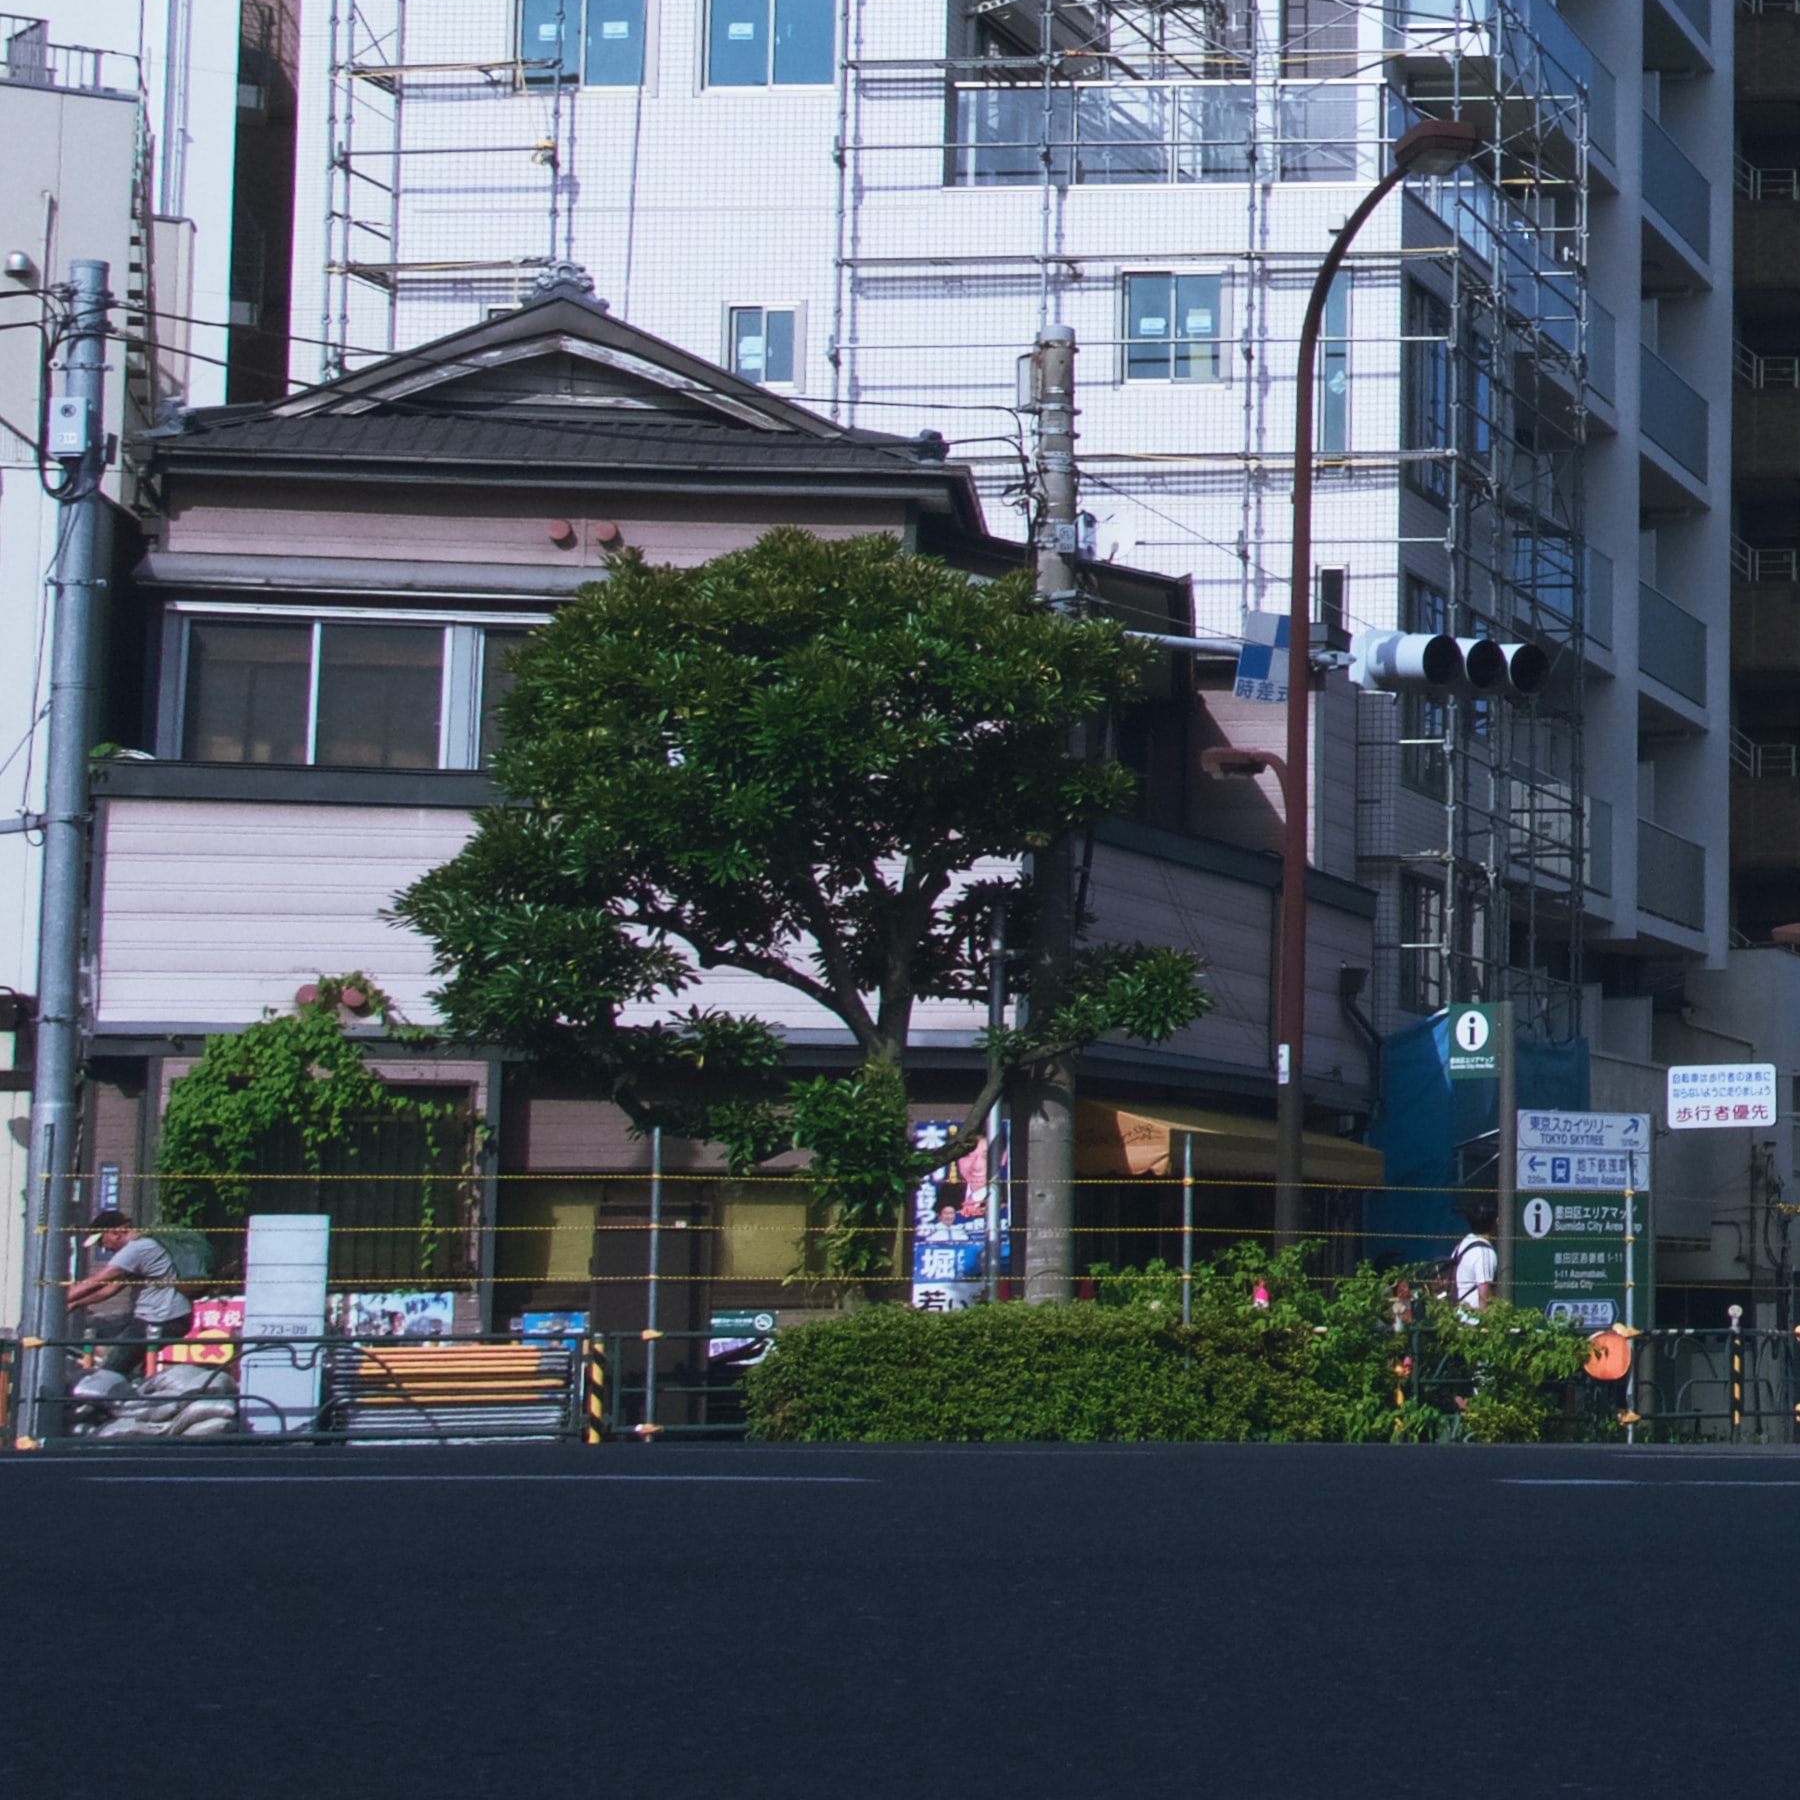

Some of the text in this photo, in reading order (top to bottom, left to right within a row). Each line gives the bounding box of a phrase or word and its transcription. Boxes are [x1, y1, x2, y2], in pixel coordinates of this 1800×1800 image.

[1676, 1104, 1768, 1122] 歩行者優先
[1530, 1116, 1614, 1133] 東京スカイツリー
[1541, 1133, 1567, 1145] TOKYO
[1570, 1134, 1604, 1146] SKYTREE
[1575, 1174, 1599, 1185] Subway
[1554, 1220, 1585, 1231] Sumida
[1587, 1220, 1604, 1233] City
[1605, 1221, 1624, 1232] Area
[921, 1248, 956, 1280] 堀
[1607, 1253, 1623, 1263] 1-11
[1554, 1279, 1594, 1291] Sumida City
